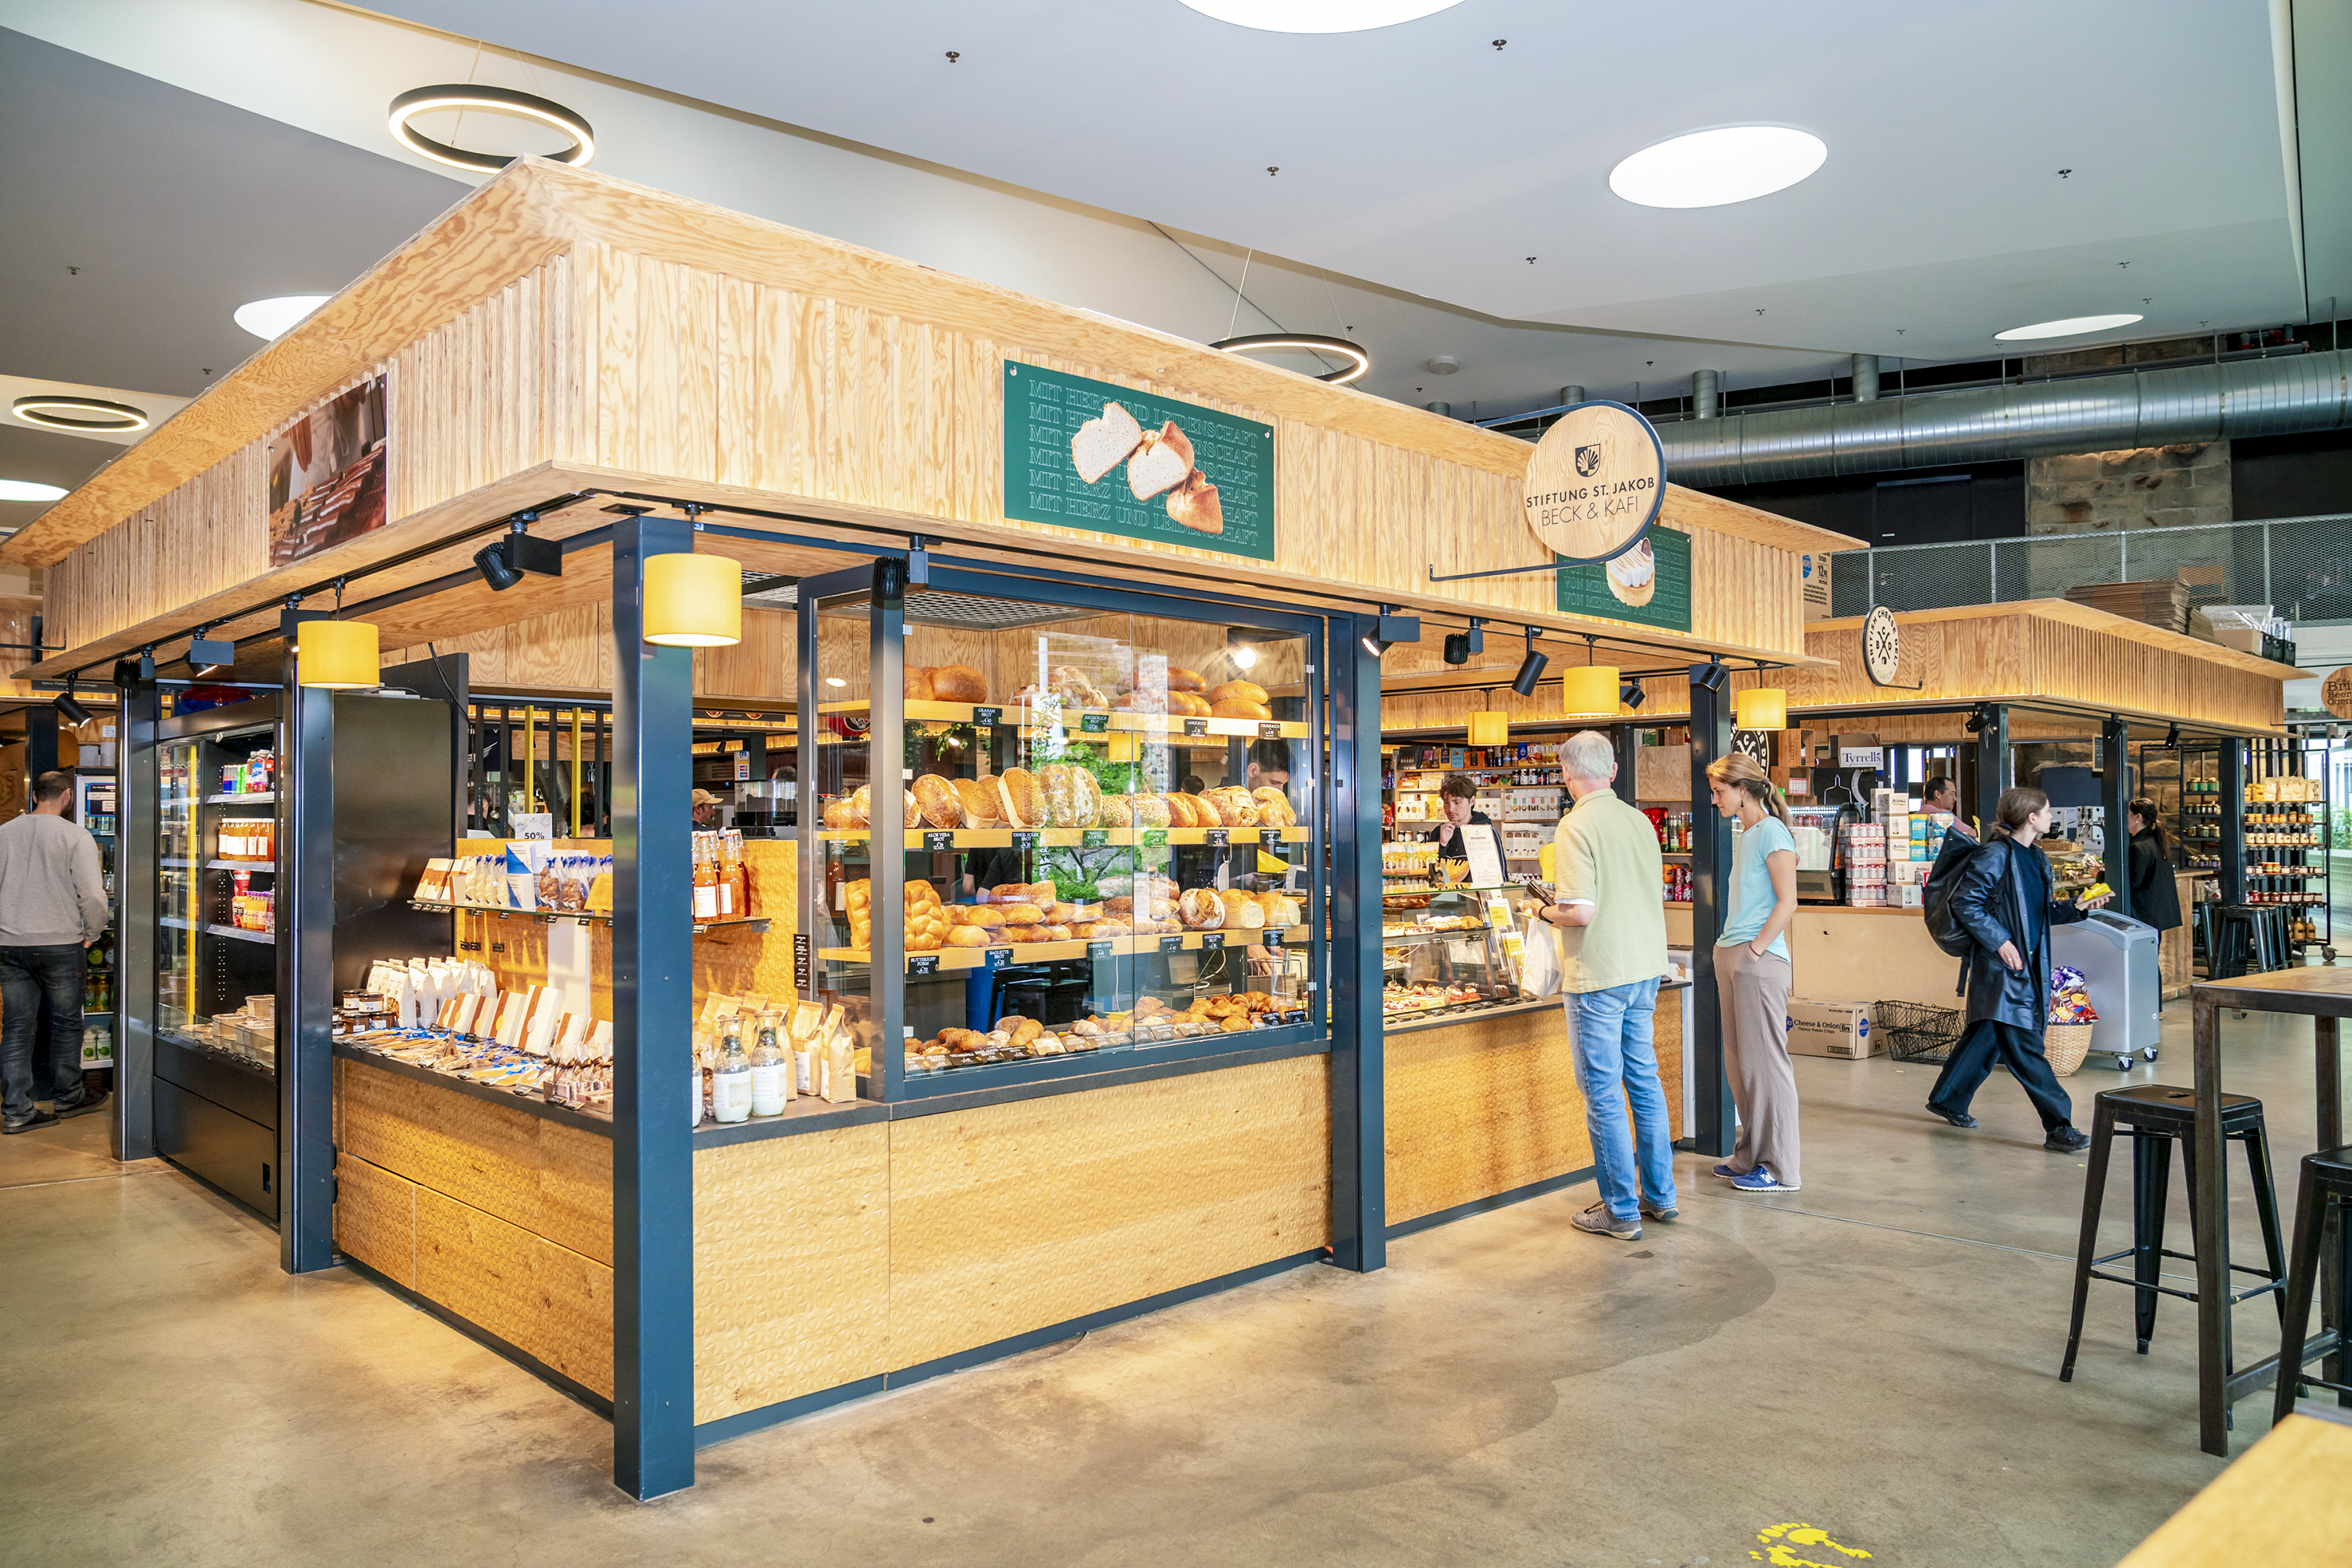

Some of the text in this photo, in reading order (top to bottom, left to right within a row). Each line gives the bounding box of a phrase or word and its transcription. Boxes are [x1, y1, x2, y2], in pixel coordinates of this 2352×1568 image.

[1029, 379, 1063, 402] MIT
[1066, 387, 1111, 413] HERZ
[1115, 398, 1150, 422] UND
[1029, 401, 1063, 424] MIT
[1029, 424, 1063, 447] MIT
[1029, 446, 1063, 468] MIT
[1029, 469, 1063, 491] MIT
[1066, 475, 1111, 499] HERZ
[1526, 477, 1655, 508] STIFTUNG ST. JAKOB
[1029, 491, 1063, 513] MIT
[1066, 497, 1111, 521] HERZ
[1115, 506, 1149, 527] UND
[1541, 495, 1638, 526] BECK & KAFI
[1563, 575, 1584, 591] VON
[1563, 592, 1584, 607] VON
[1586, 595, 1631, 615] MENSCHEN
[1869, 616, 1877, 665] BRITISH
[1877, 609, 1896, 634] CHEESE
[1881, 626, 1885, 635] C
[1876, 640, 1892, 651] B D
[2326, 680, 2352, 691] Bri
